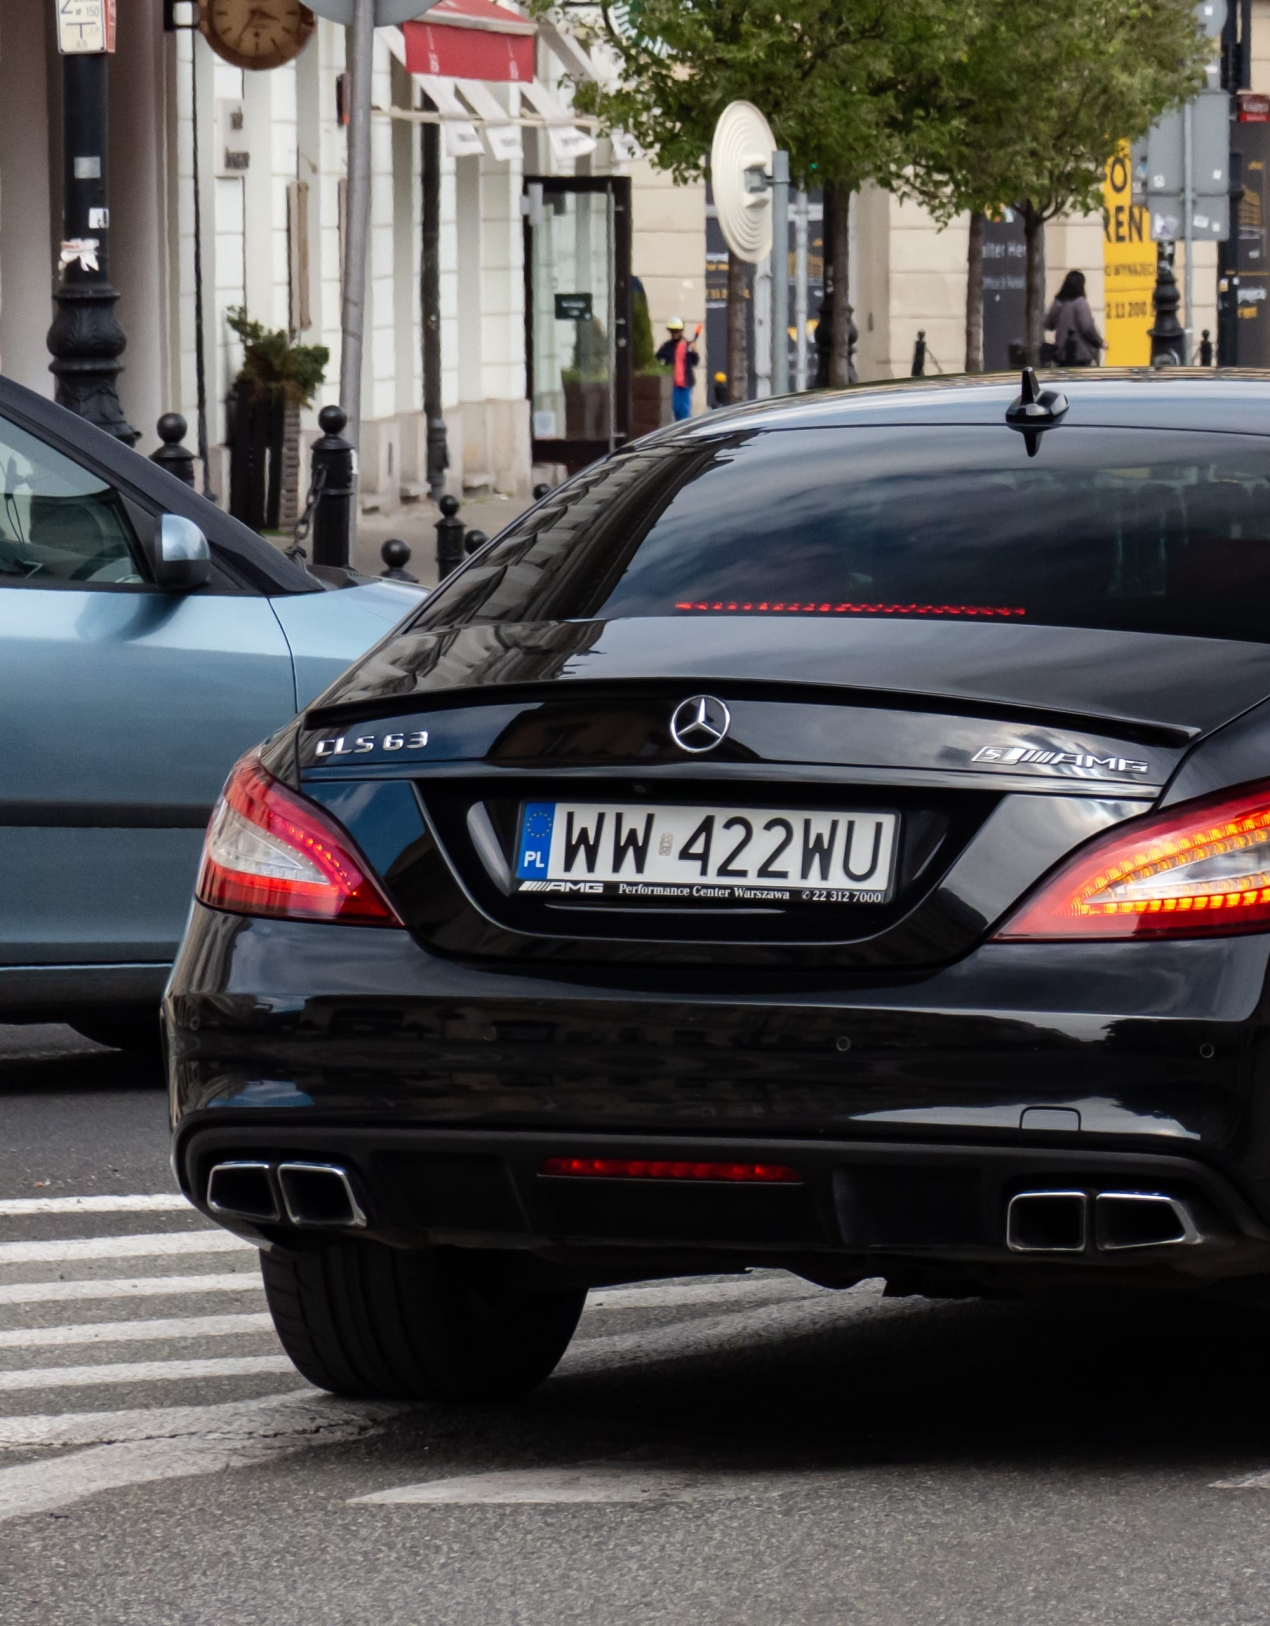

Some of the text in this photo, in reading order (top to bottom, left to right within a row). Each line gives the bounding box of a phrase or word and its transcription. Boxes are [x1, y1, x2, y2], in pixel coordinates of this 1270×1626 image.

[315, 731, 429, 757] CLS 63
[1051, 753, 1148, 774] AMG
[563, 810, 884, 882] WW 422WU
[523, 850, 546, 868] PL
[618, 883, 690, 898] Performance
[692, 886, 731, 899] Center
[733, 888, 790, 900] Warszawa
[812, 890, 826, 901] 22
[830, 891, 849, 902] 312
[853, 892, 881, 903] 7000
